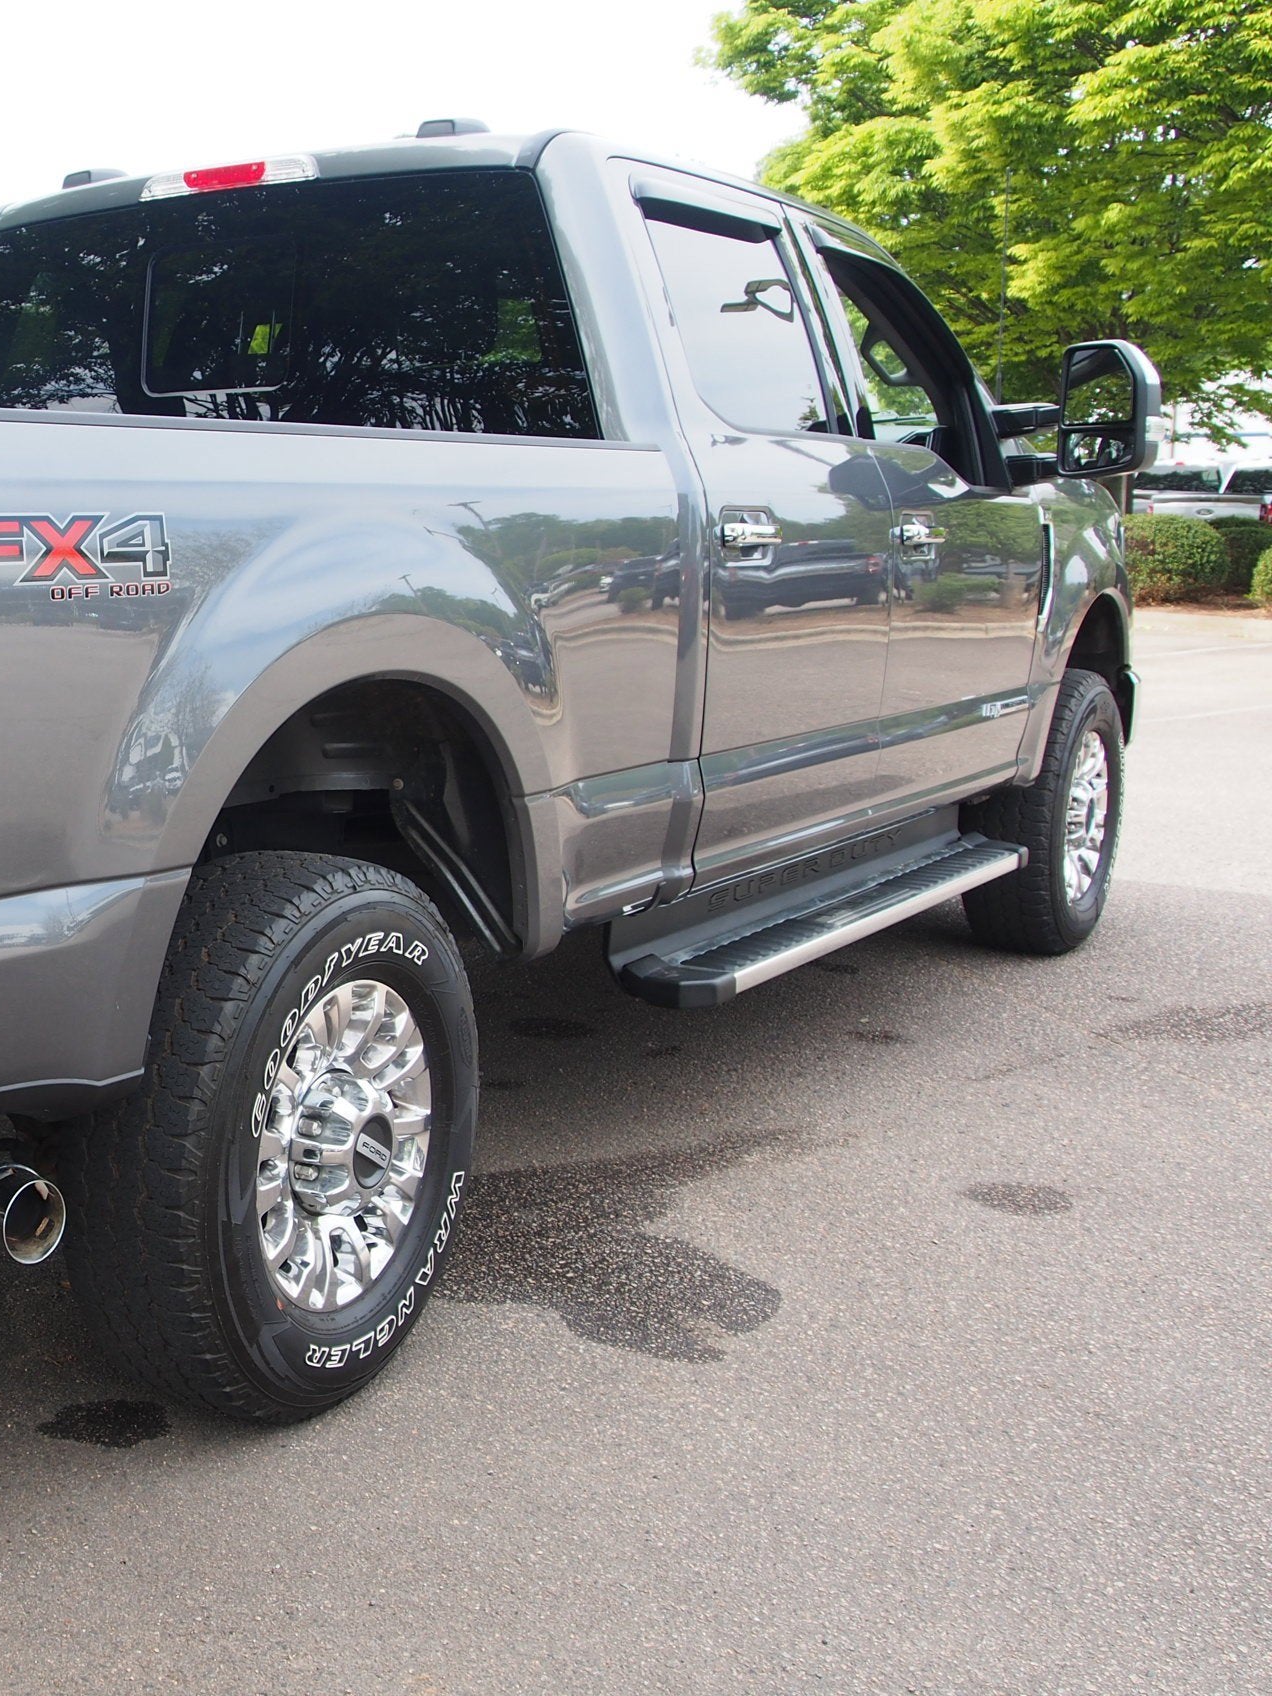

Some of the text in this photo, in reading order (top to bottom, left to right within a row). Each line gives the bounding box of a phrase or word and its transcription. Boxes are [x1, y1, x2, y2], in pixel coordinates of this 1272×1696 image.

[50, 580, 172, 601] OFF ROAD
[707, 829, 903, 913] SUPER DUTY
[251, 931, 429, 1138] GOODYEAR
[361, 1141, 387, 1162] FORD
[305, 1171, 465, 1368] WRANGLER
